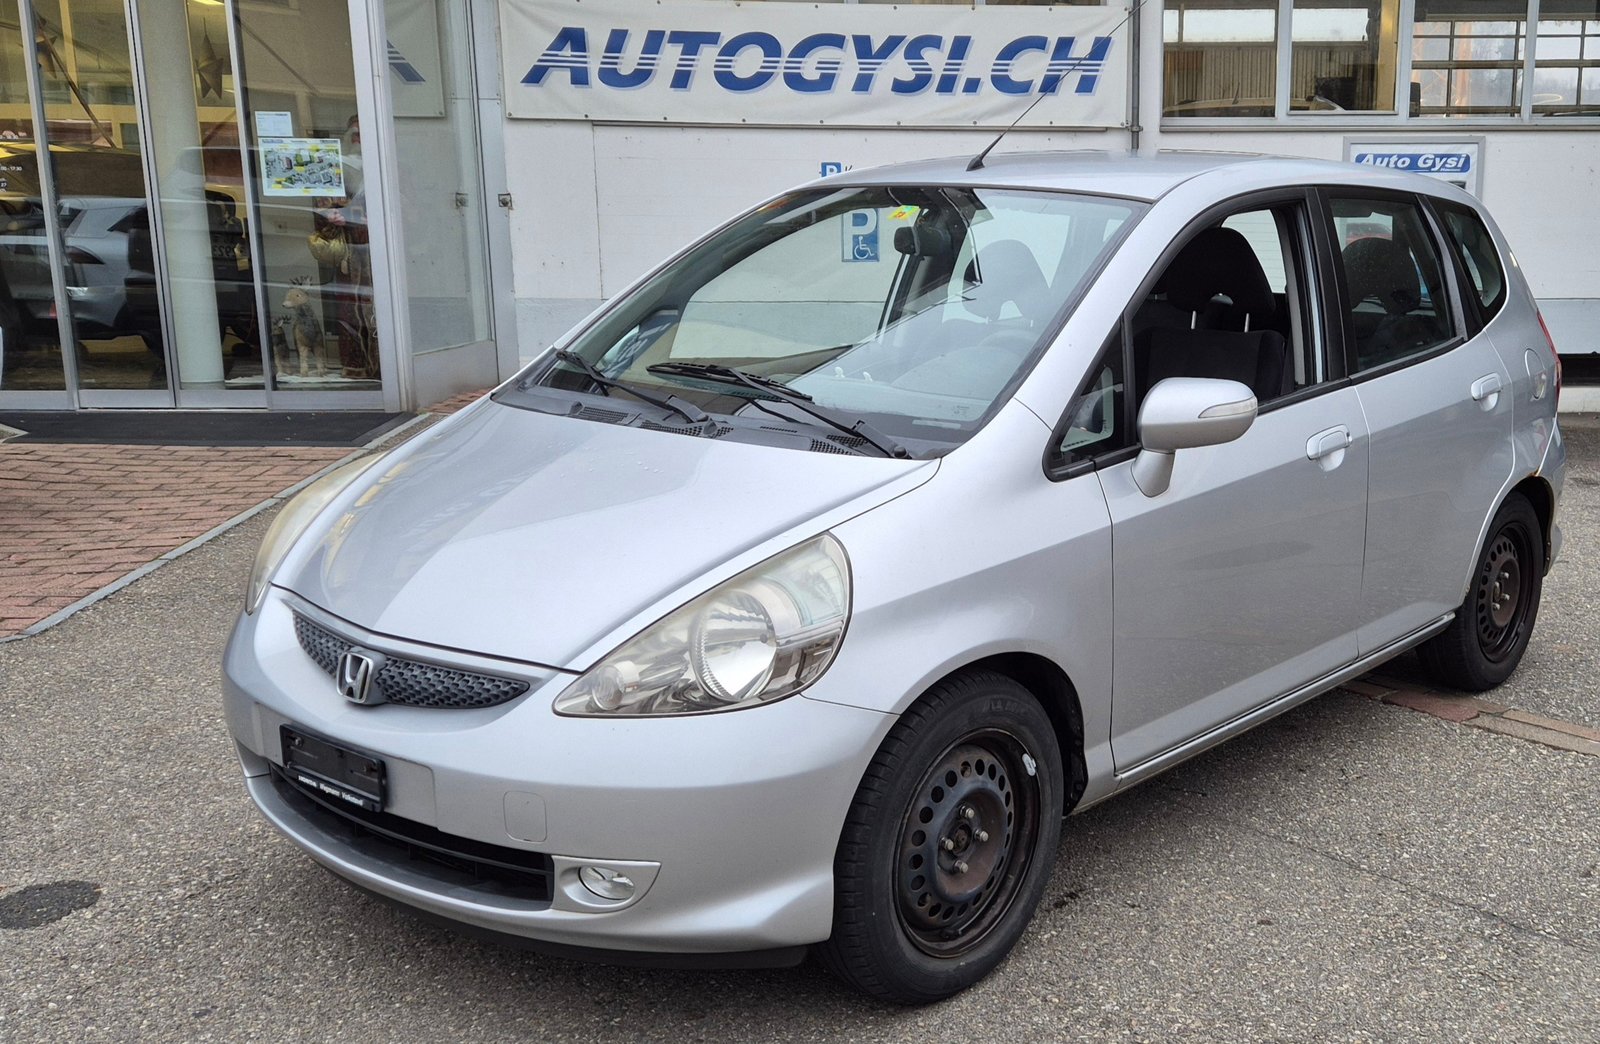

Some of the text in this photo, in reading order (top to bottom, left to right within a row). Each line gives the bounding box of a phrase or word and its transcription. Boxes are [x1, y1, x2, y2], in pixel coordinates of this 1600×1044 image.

[520, 26, 1114, 95] AUTOGYSI.CH
[1360, 154, 1467, 171] Auto Gysi
[844, 208, 877, 260] P
